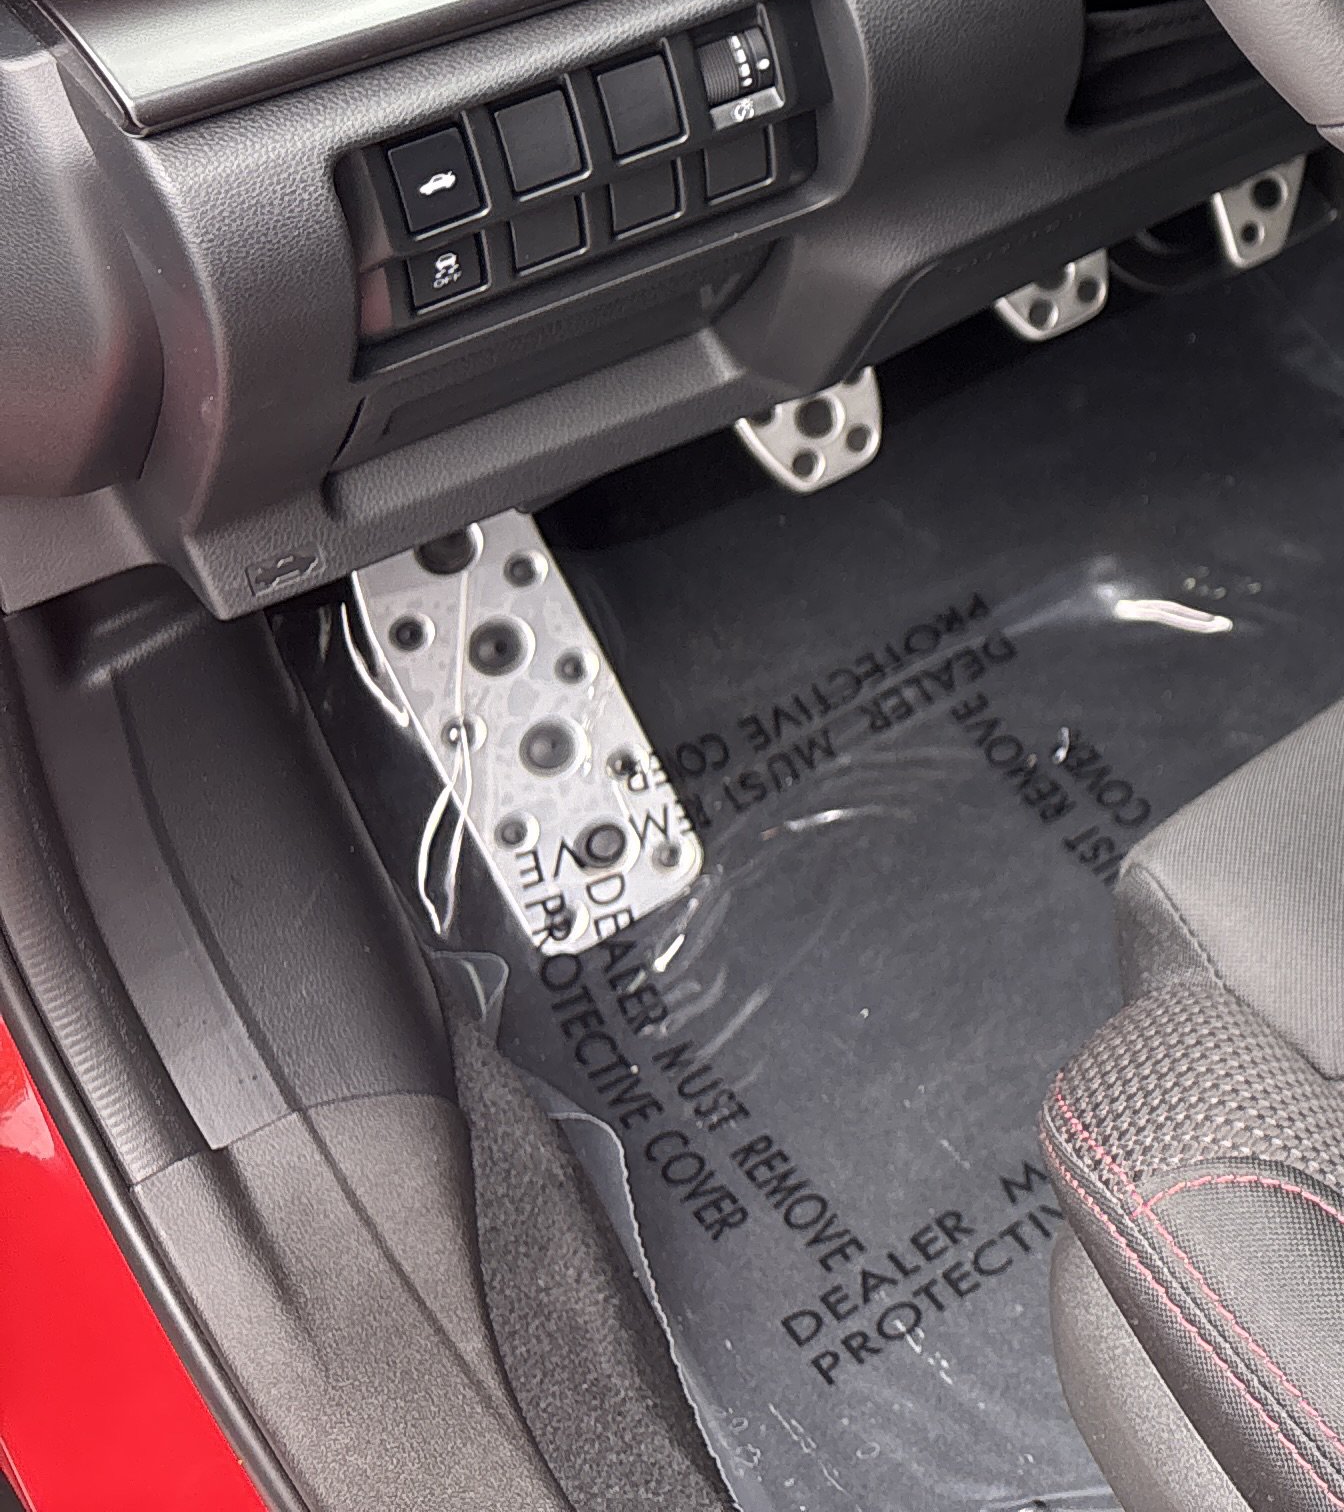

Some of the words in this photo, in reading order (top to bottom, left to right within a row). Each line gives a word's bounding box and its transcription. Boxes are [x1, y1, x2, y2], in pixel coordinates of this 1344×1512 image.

[433, 270, 462, 289] OFF
[736, 590, 992, 753] PROTECTIVE
[860, 631, 1018, 732] DEALER
[725, 727, 836, 813] MUST
[644, 1129, 750, 1241] COVER
[652, 1039, 750, 1133] MUST
[729, 1133, 868, 1274] REMOVE
[780, 1208, 978, 1349] DEALER
